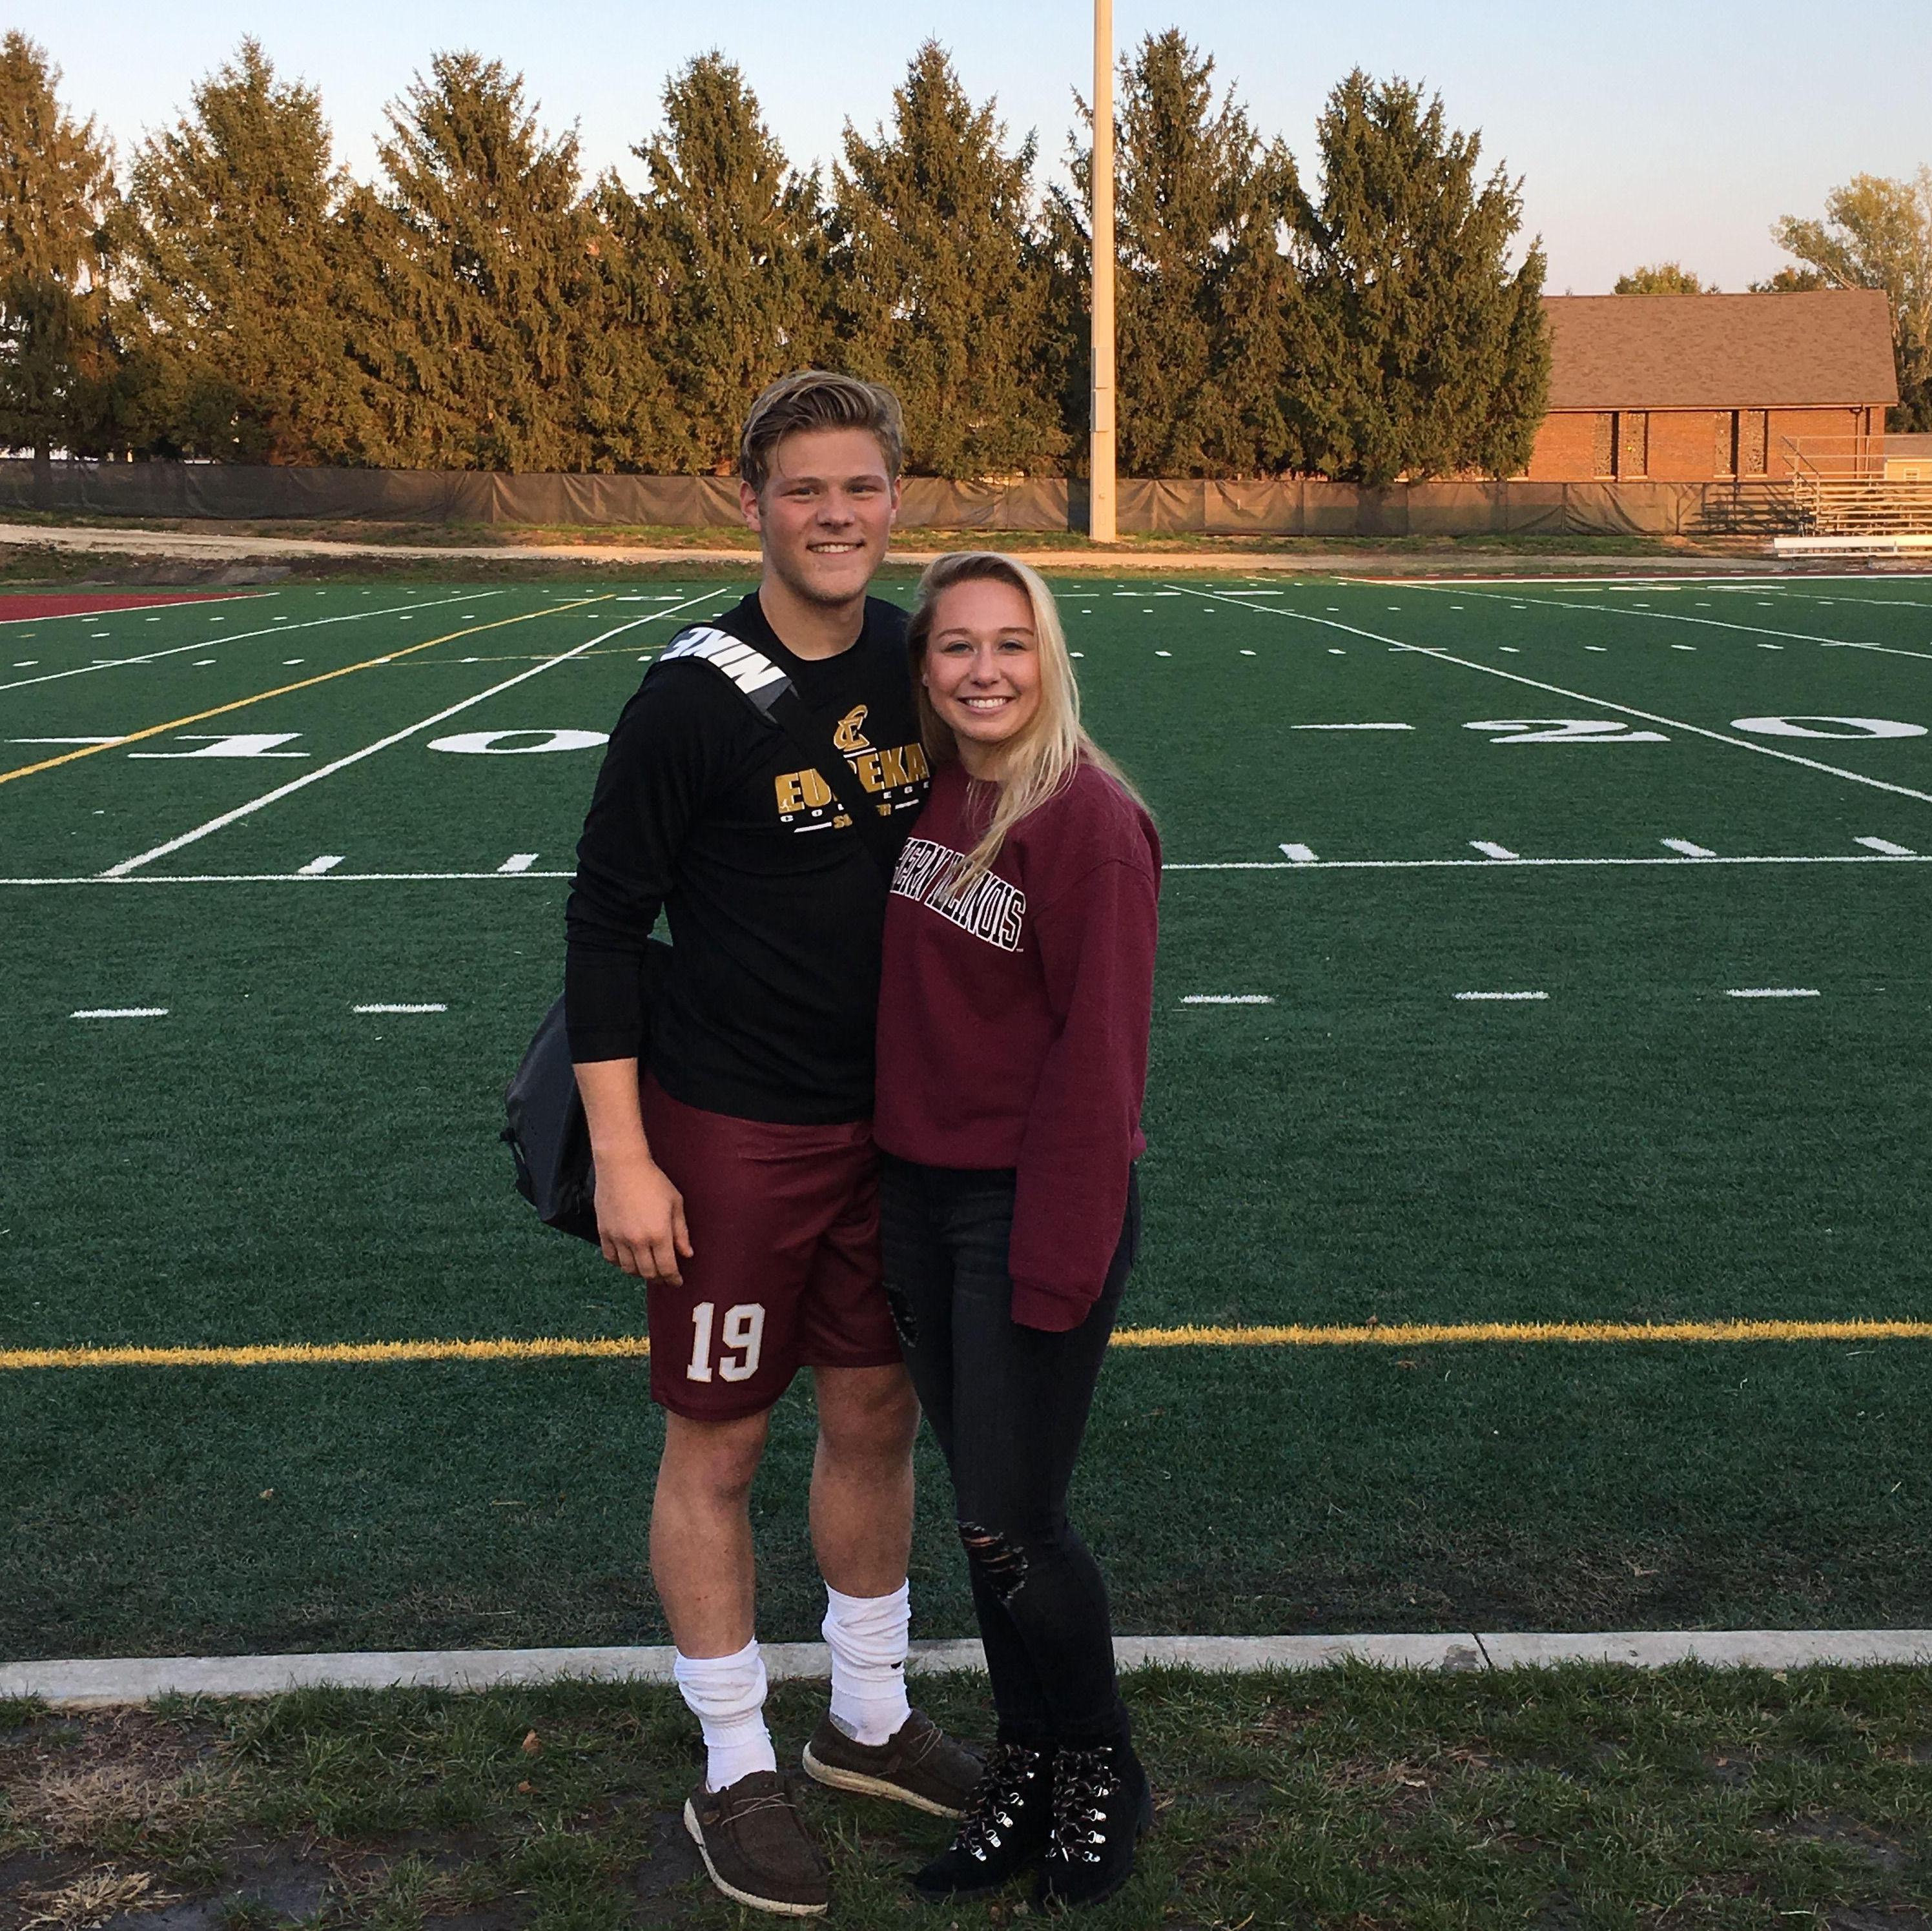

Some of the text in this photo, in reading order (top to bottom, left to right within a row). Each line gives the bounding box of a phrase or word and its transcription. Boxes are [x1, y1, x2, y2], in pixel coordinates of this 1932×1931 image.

[660, 627, 787, 694] NIKE
[775, 742, 930, 814] EUEKA
[687, 1302, 766, 1382] 19
